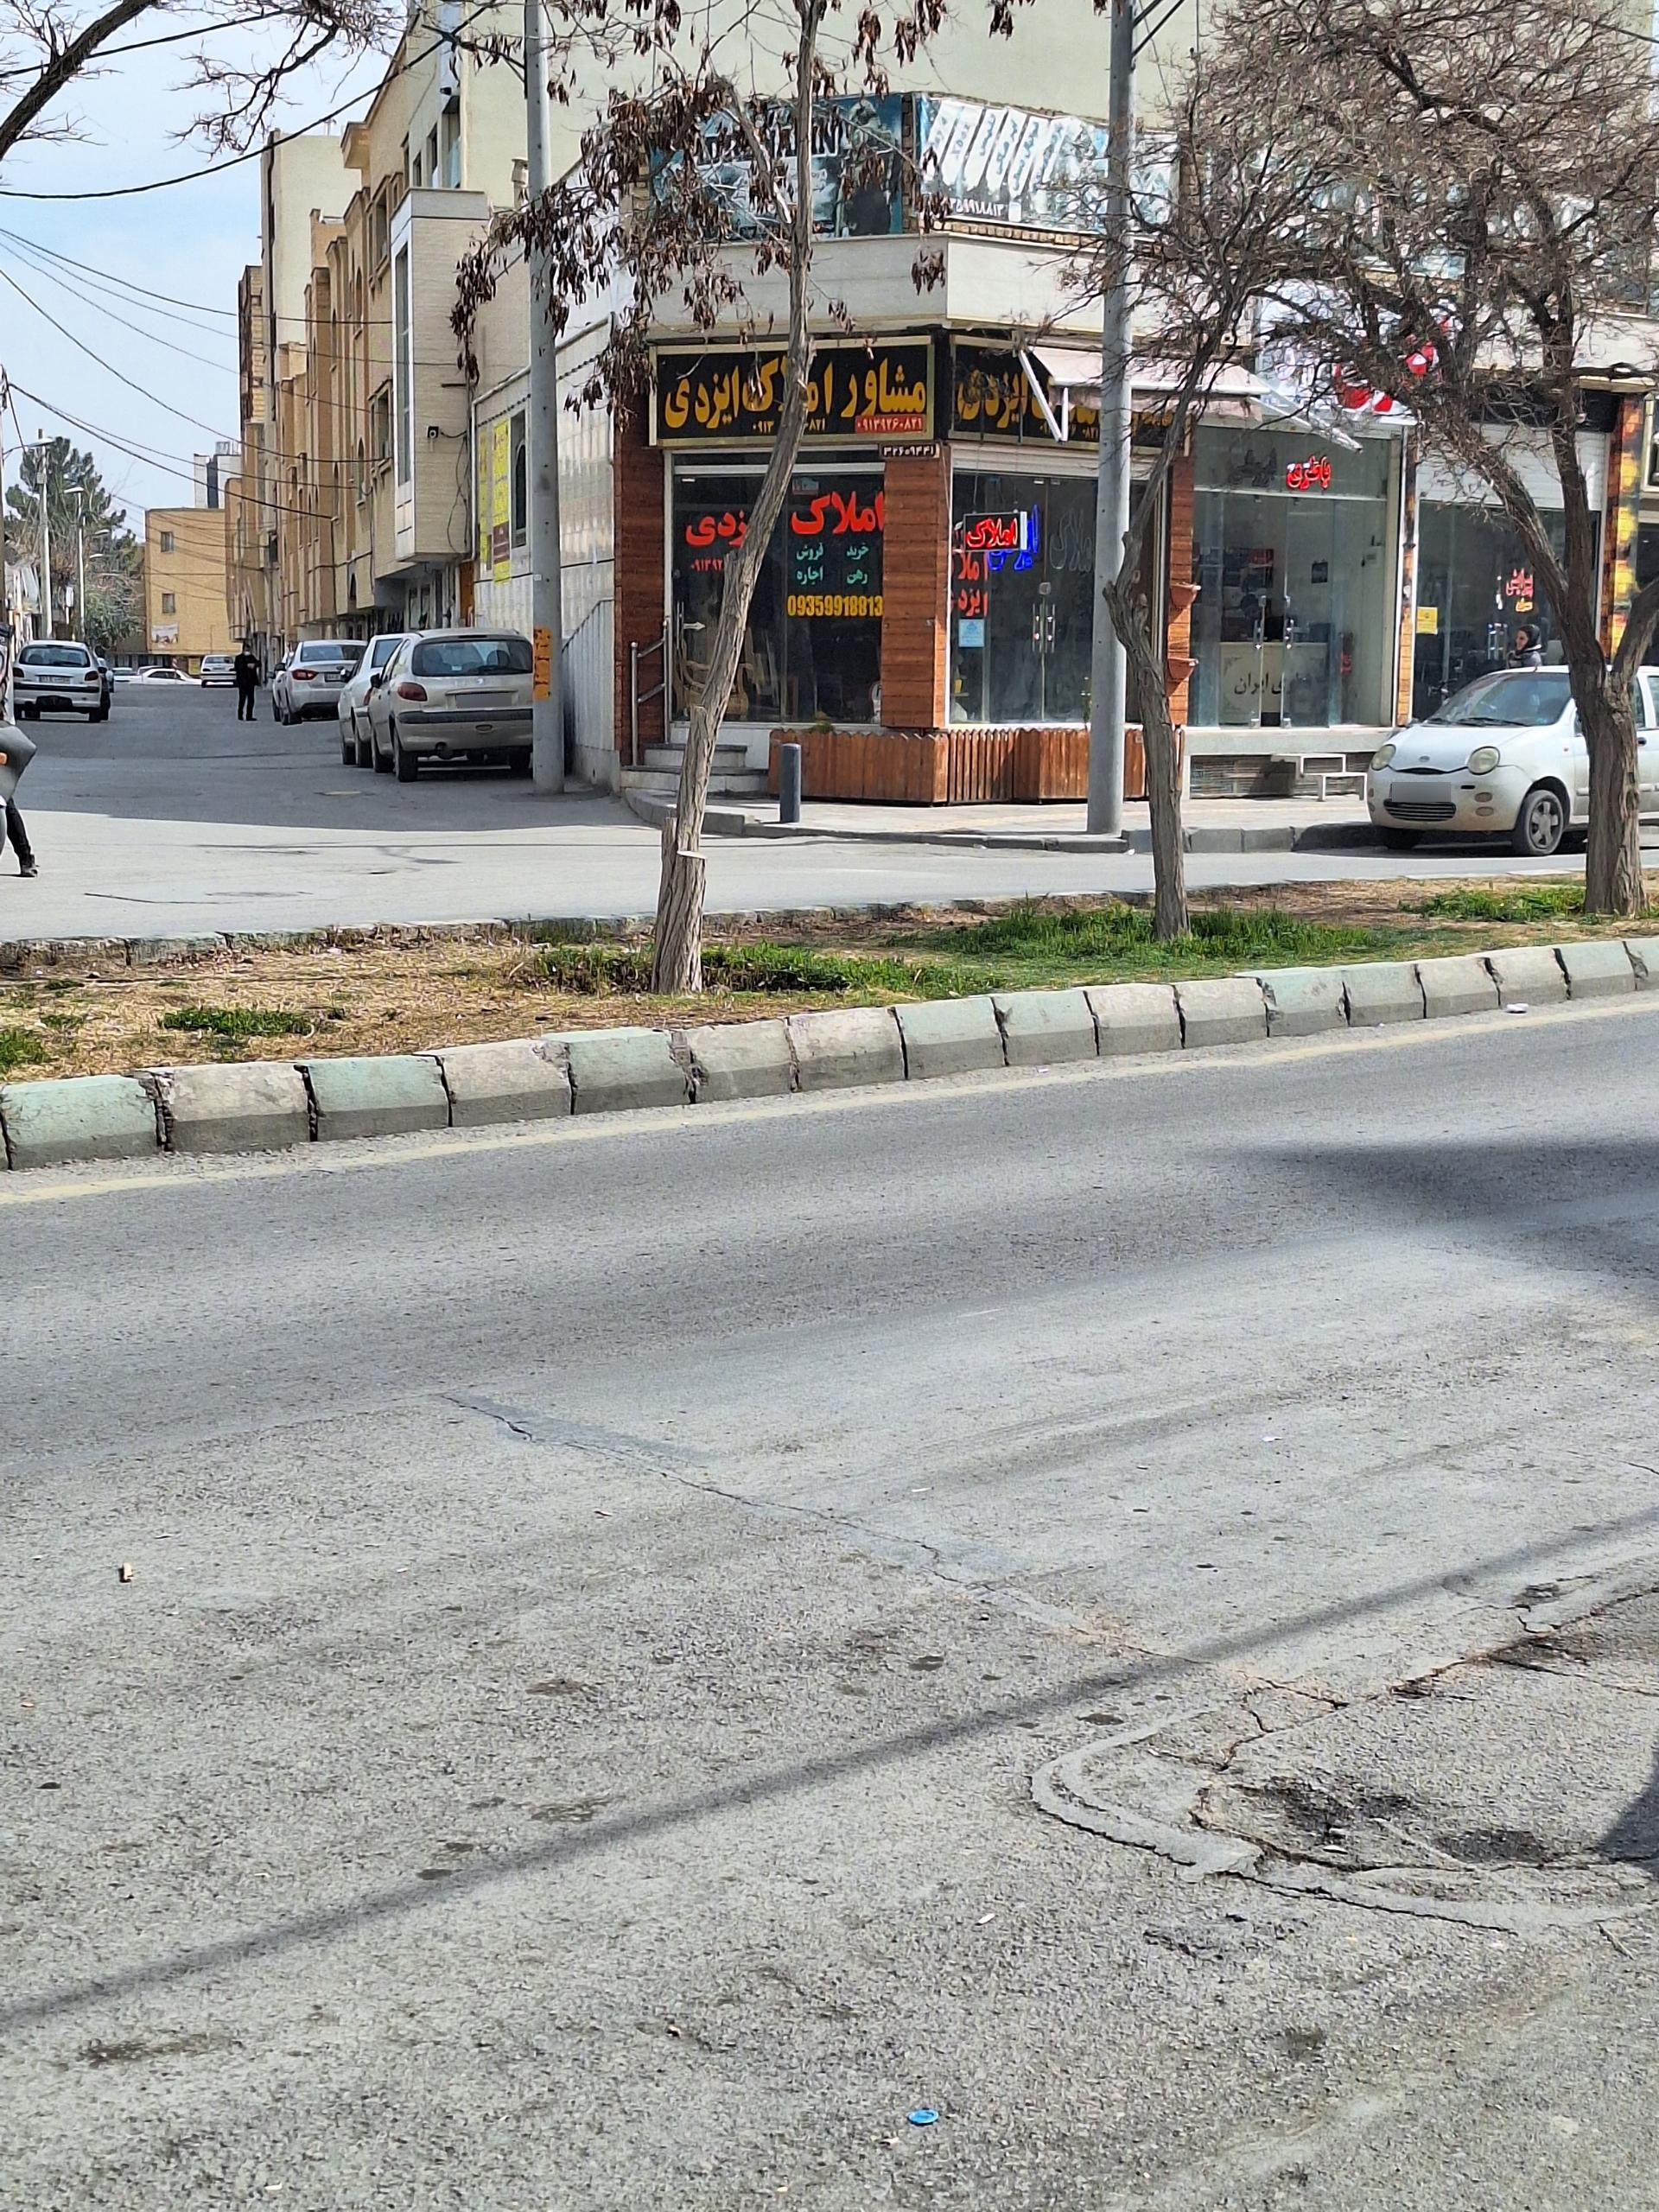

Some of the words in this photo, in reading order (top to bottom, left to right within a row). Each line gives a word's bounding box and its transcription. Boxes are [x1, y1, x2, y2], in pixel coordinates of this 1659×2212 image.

[664, 365, 740, 429] ایزدی
[841, 357, 926, 418] مشاور
[791, 490, 885, 535] املاک
[966, 517, 1019, 549] املاک
[796, 542, 823, 561] فروش
[846, 542, 869, 561] خرید
[796, 566, 823, 586] اجاره
[846, 566, 868, 585] رهن
[787, 594, 884, 618] 09359918813
